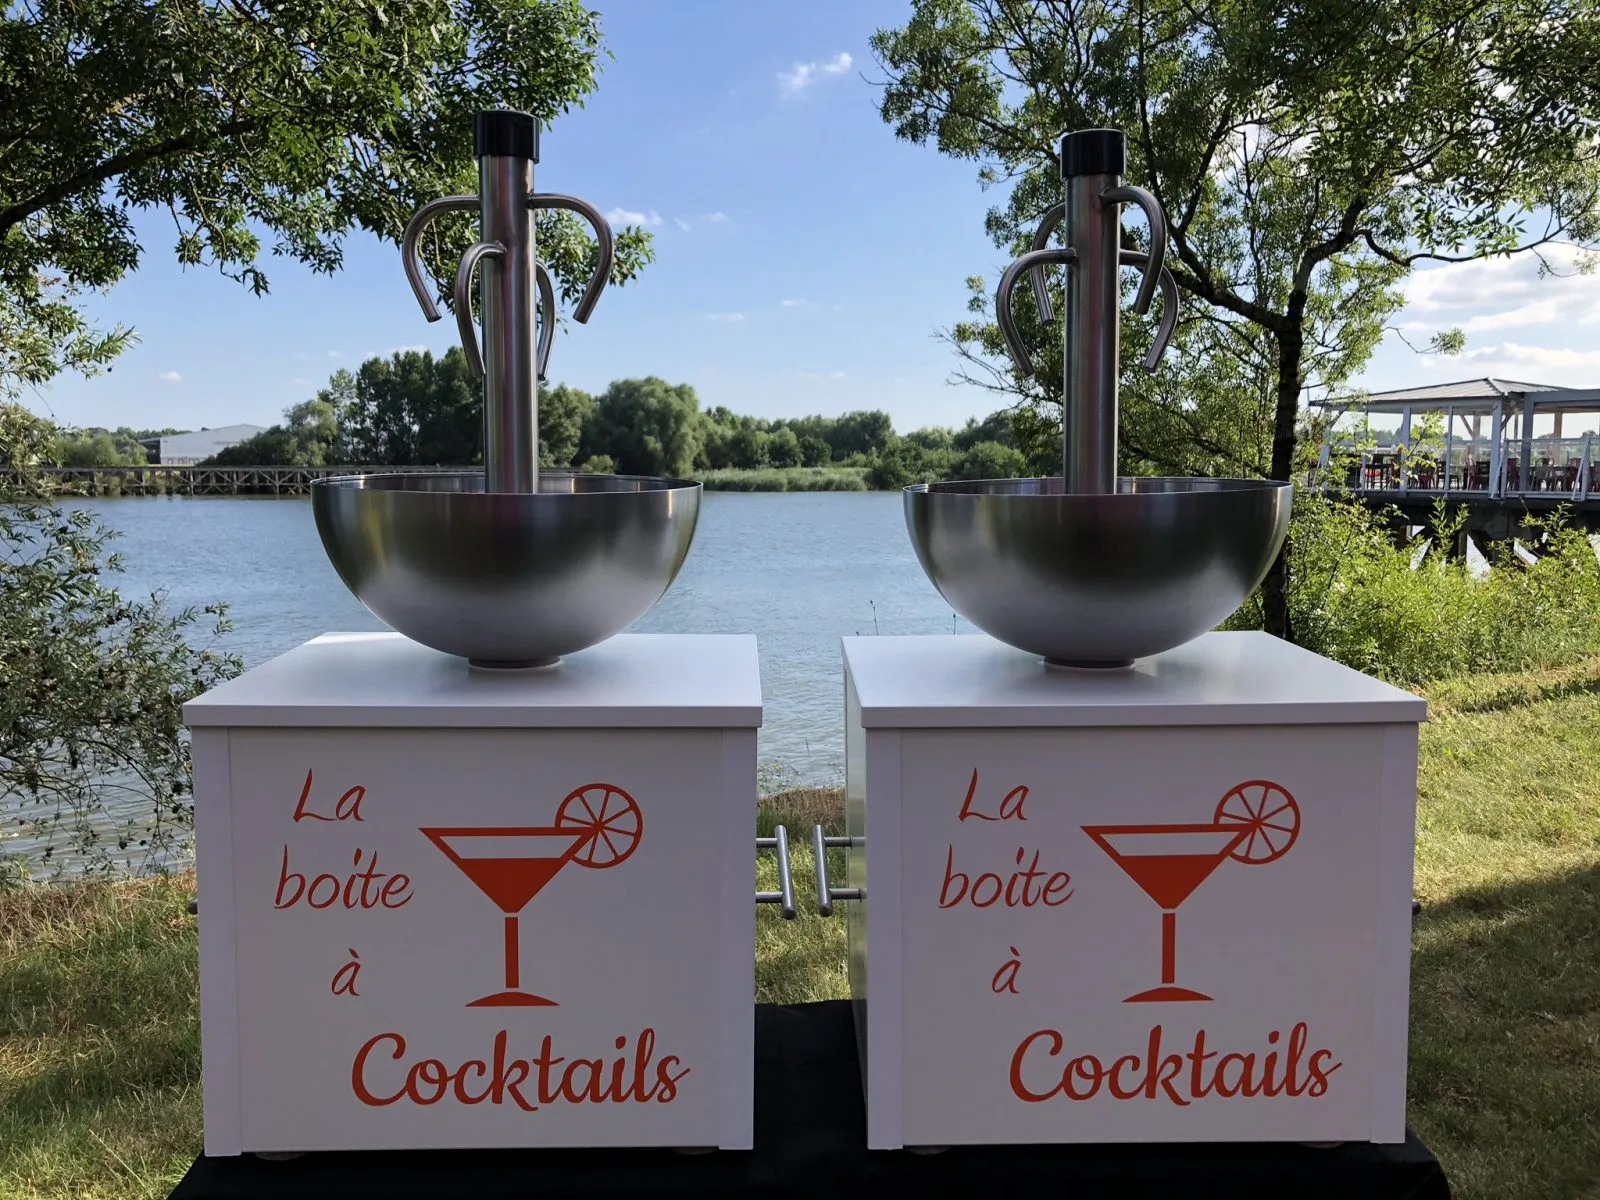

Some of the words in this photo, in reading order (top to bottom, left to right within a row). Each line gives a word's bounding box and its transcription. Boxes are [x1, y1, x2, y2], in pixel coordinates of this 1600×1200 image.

[293, 767, 365, 823] La
[958, 767, 1029, 822] La
[330, 948, 361, 997] à
[991, 946, 1021, 994] à
[351, 1028, 691, 1112] Cocktails
[1009, 1021, 1343, 1107] Cocktails
